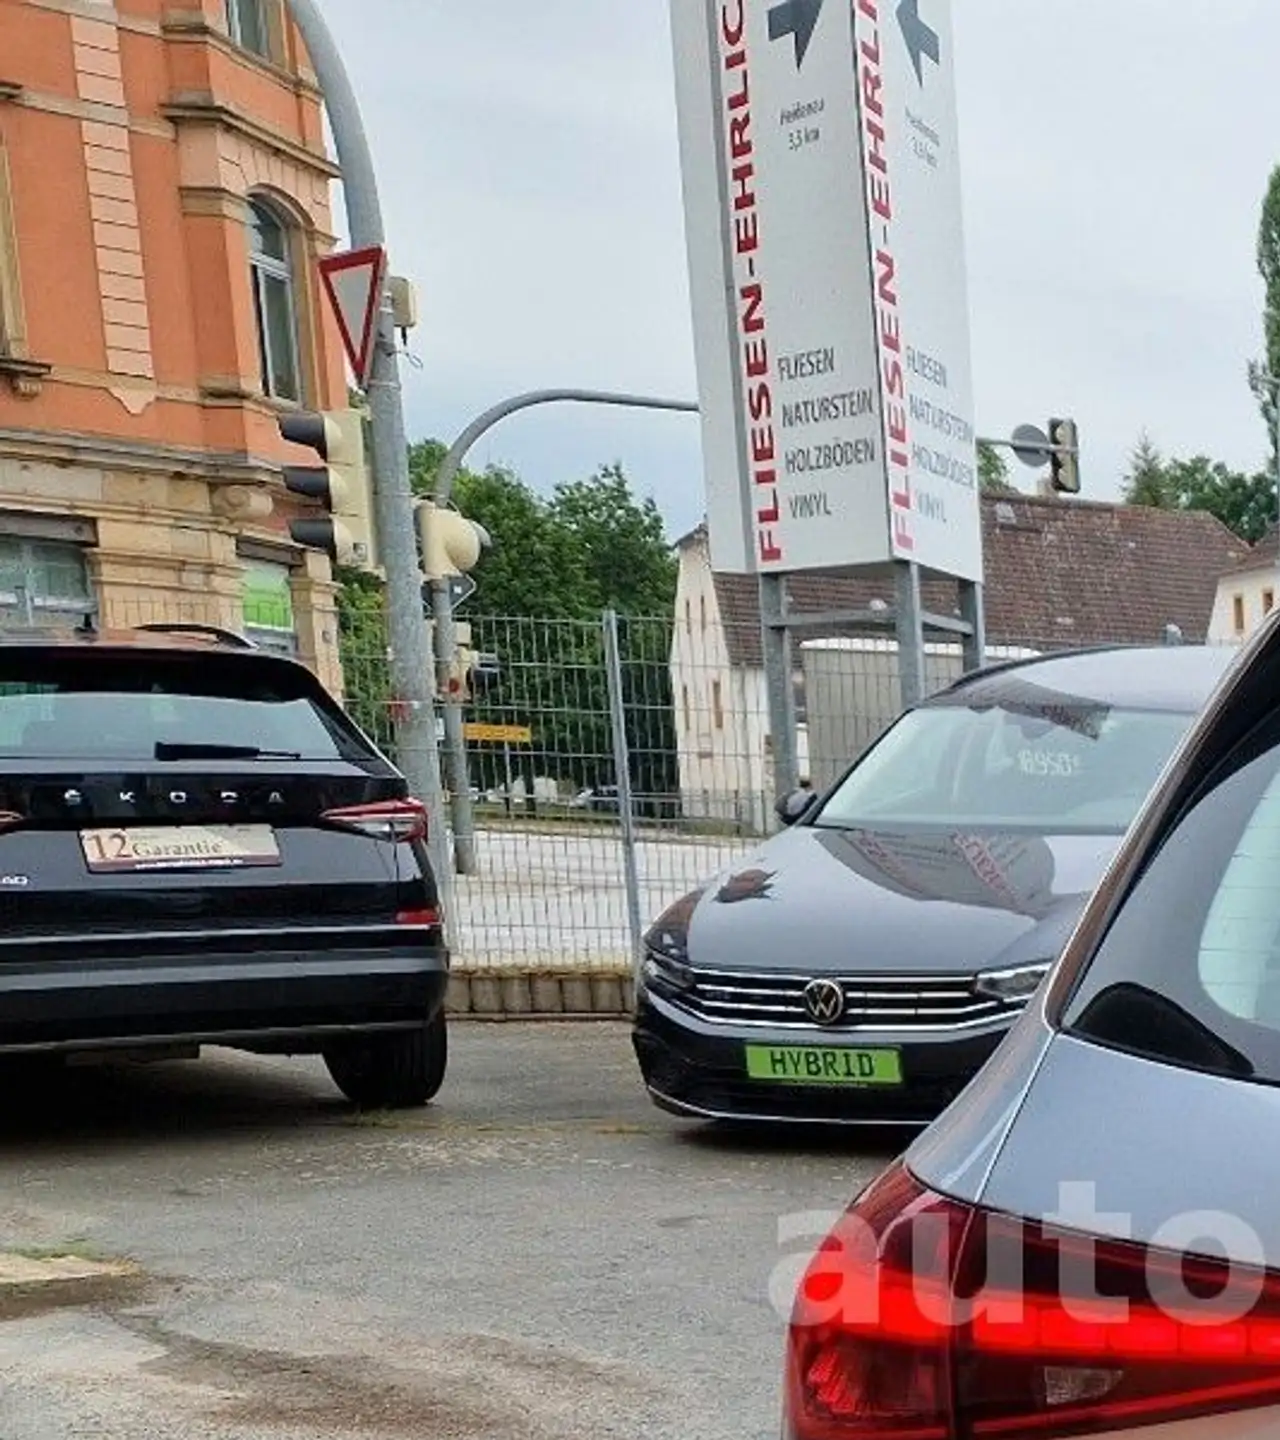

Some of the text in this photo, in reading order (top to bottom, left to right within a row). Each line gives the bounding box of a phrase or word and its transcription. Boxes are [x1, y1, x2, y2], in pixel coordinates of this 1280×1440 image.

[777, 347, 835, 383] FLIESEN
[782, 388, 873, 428] NATURSTEIN
[785, 437, 875, 474] HOLZBÖDEN
[789, 491, 832, 520] VINYL
[89, 832, 133, 860] 12
[769, 1050, 876, 1078] HYBRID
